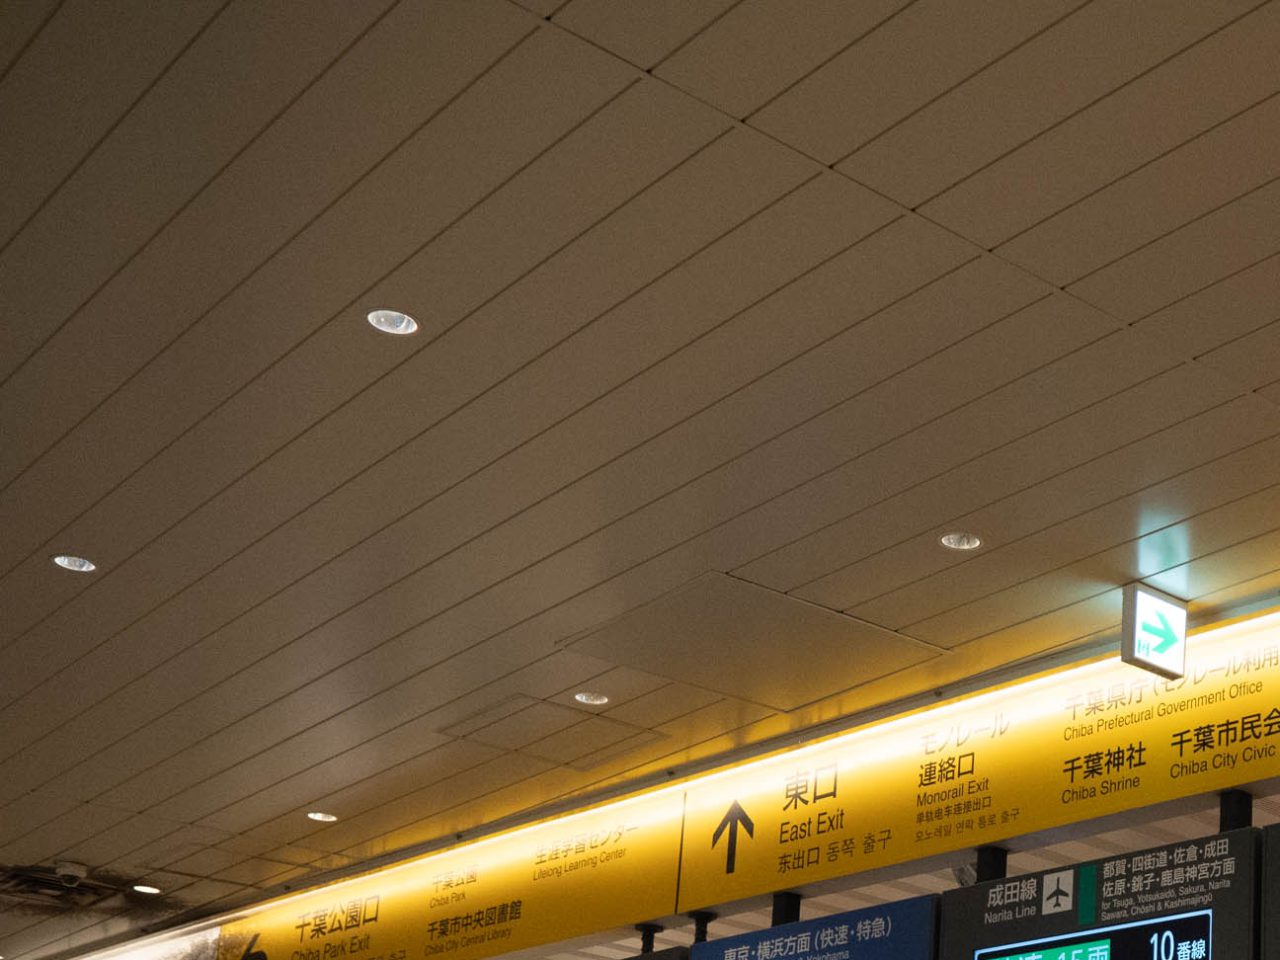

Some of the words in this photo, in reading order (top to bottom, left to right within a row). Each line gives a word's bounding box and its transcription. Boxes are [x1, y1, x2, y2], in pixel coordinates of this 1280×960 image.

[1064, 720, 1093, 741] Chiba
[1097, 707, 1153, 730] Prefectural
[1157, 691, 1225, 717] Government
[1229, 680, 1263, 698] Office
[918, 753, 975, 788] 連絡口
[1063, 741, 1147, 783] 千葉神社
[1170, 760, 1208, 779] Chiba
[1212, 752, 1237, 770] City
[1242, 744, 1274, 762] Civic
[782, 763, 839, 811] 東口
[917, 785, 963, 807] Monorail
[968, 778, 988, 795] Exit
[1062, 786, 1096, 804] Chiba
[1100, 775, 1140, 795] Shrine
[779, 817, 811, 844] East
[817, 808, 844, 834] Exit
[533, 862, 562, 881] Lifelong
[563, 853, 598, 875] Learning
[600, 847, 626, 864] Center
[430, 896, 449, 909] Chiba
[450, 892, 466, 904] Park
[987, 879, 1037, 907] 成田線
[296, 895, 380, 943] 千葉公園口
[427, 900, 522, 941] 千葉市中央図書館
[984, 910, 1012, 924] Narita
[1016, 906, 1036, 918] Line
[323, 941, 346, 960] Park
[350, 934, 370, 952] Exit
[425, 944, 444, 956] Chiba
[445, 939, 459, 953] City
[460, 933, 485, 948] Central
[487, 928, 512, 941] Library
